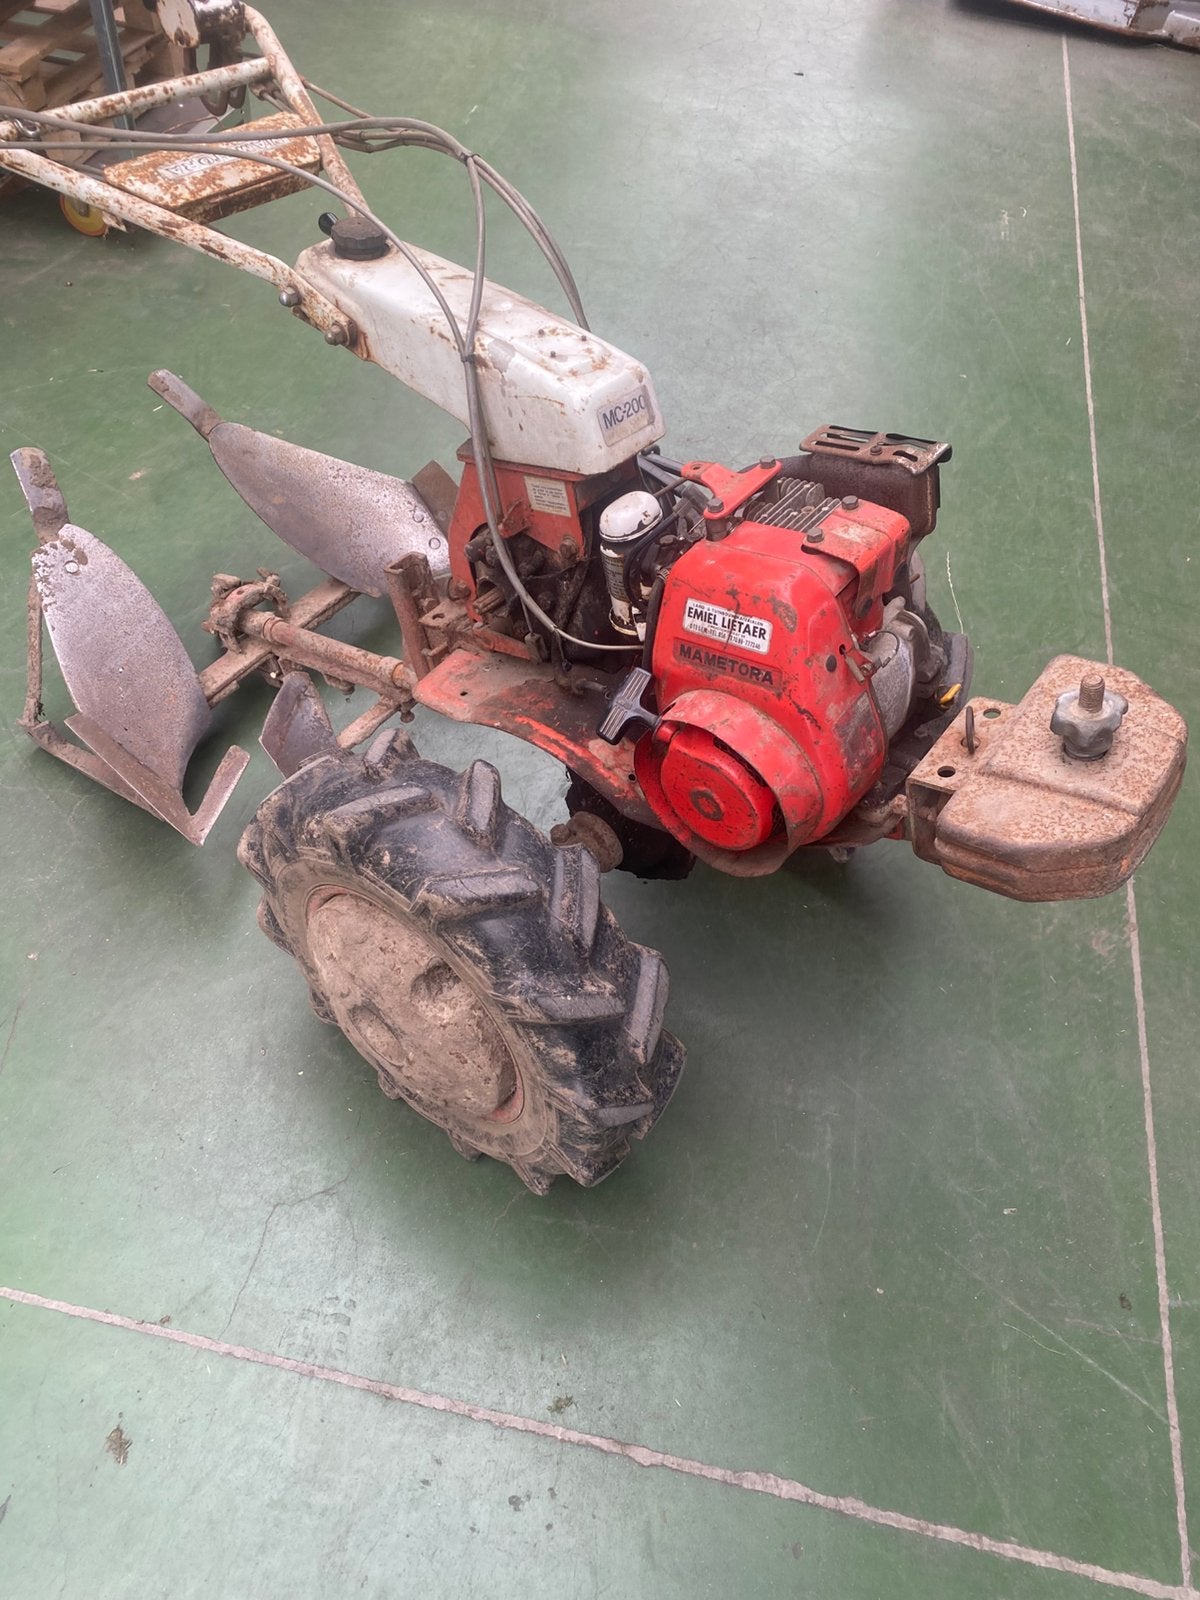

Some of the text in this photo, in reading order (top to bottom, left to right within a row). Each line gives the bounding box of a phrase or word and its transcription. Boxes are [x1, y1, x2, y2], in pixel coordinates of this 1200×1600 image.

[602, 394, 646, 429] MC-200
[687, 606, 718, 626] EMIEL
[721, 616, 767, 640] LIETAER
[679, 644, 774, 685] MAMETORA
